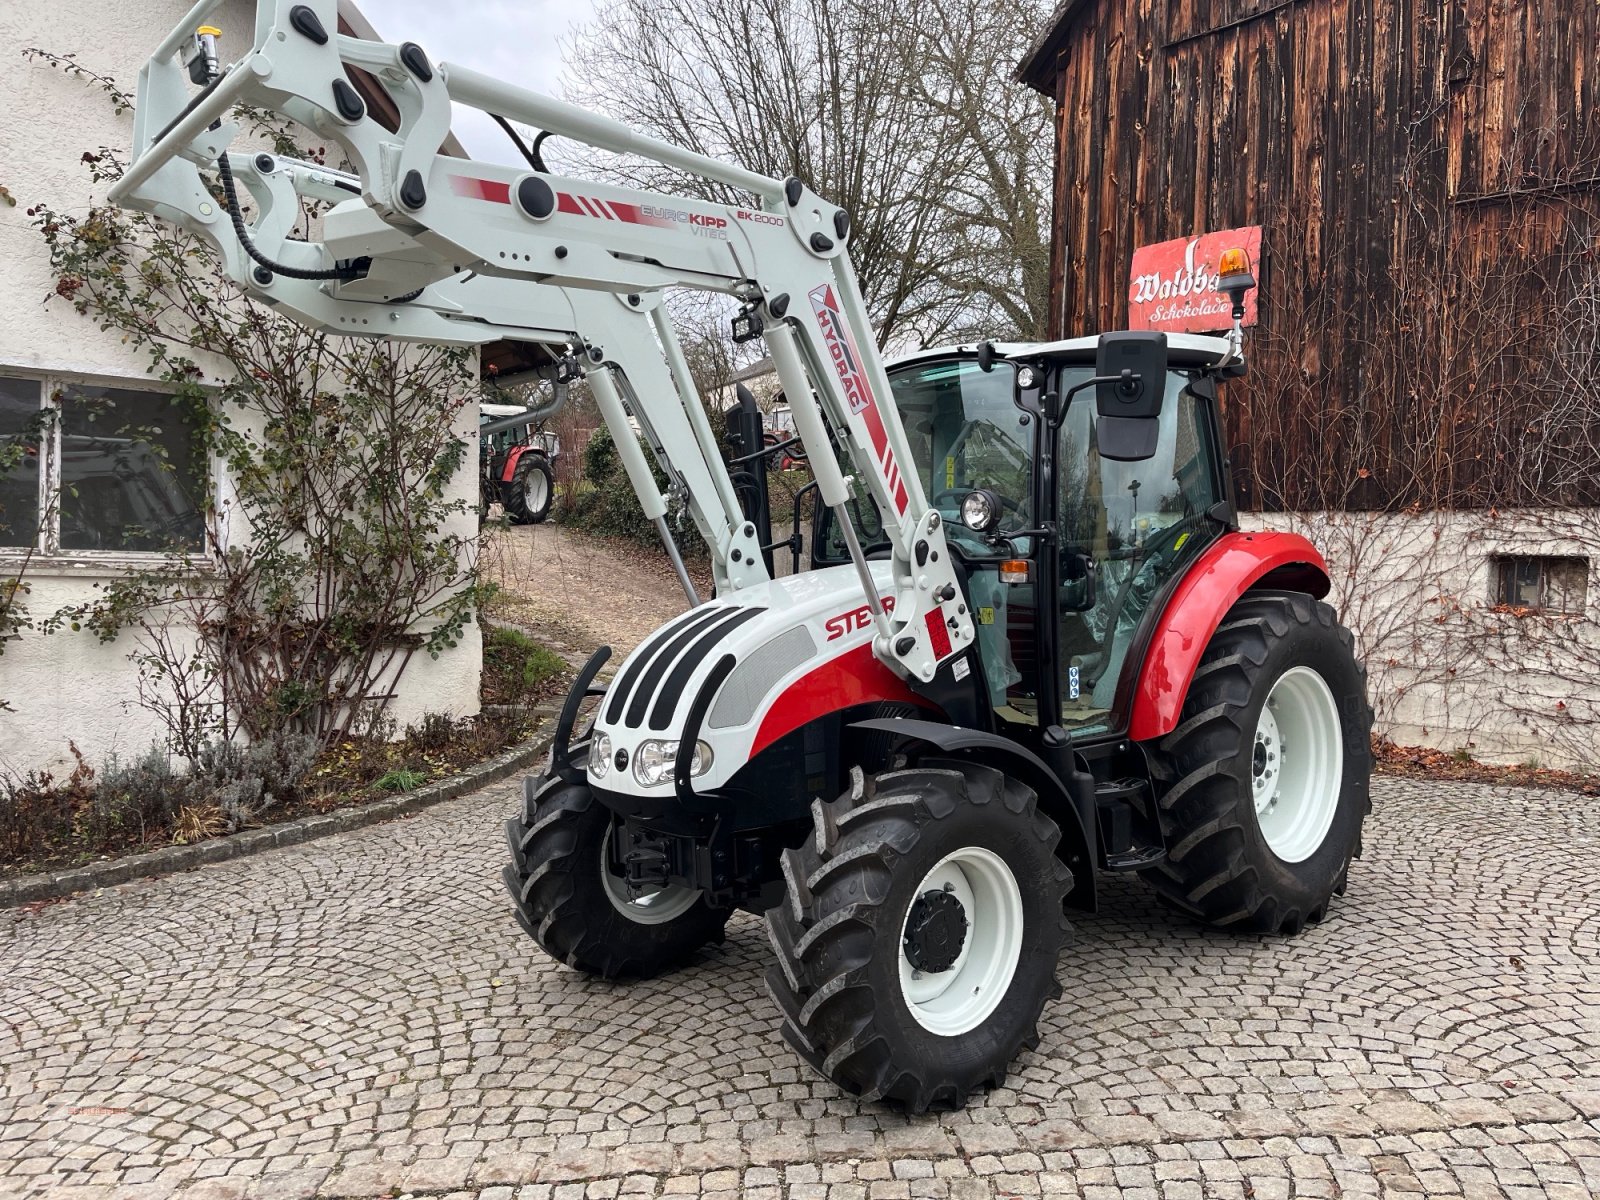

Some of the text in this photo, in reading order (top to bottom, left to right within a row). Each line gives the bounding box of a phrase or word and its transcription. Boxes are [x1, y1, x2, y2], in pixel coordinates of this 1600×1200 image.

[640, 204, 784, 229] EUROKIPP EK 2000
[1150, 297, 1230, 322] Schokolade
[817, 309, 860, 408] HYDRAC
[825, 595, 896, 642] STER
